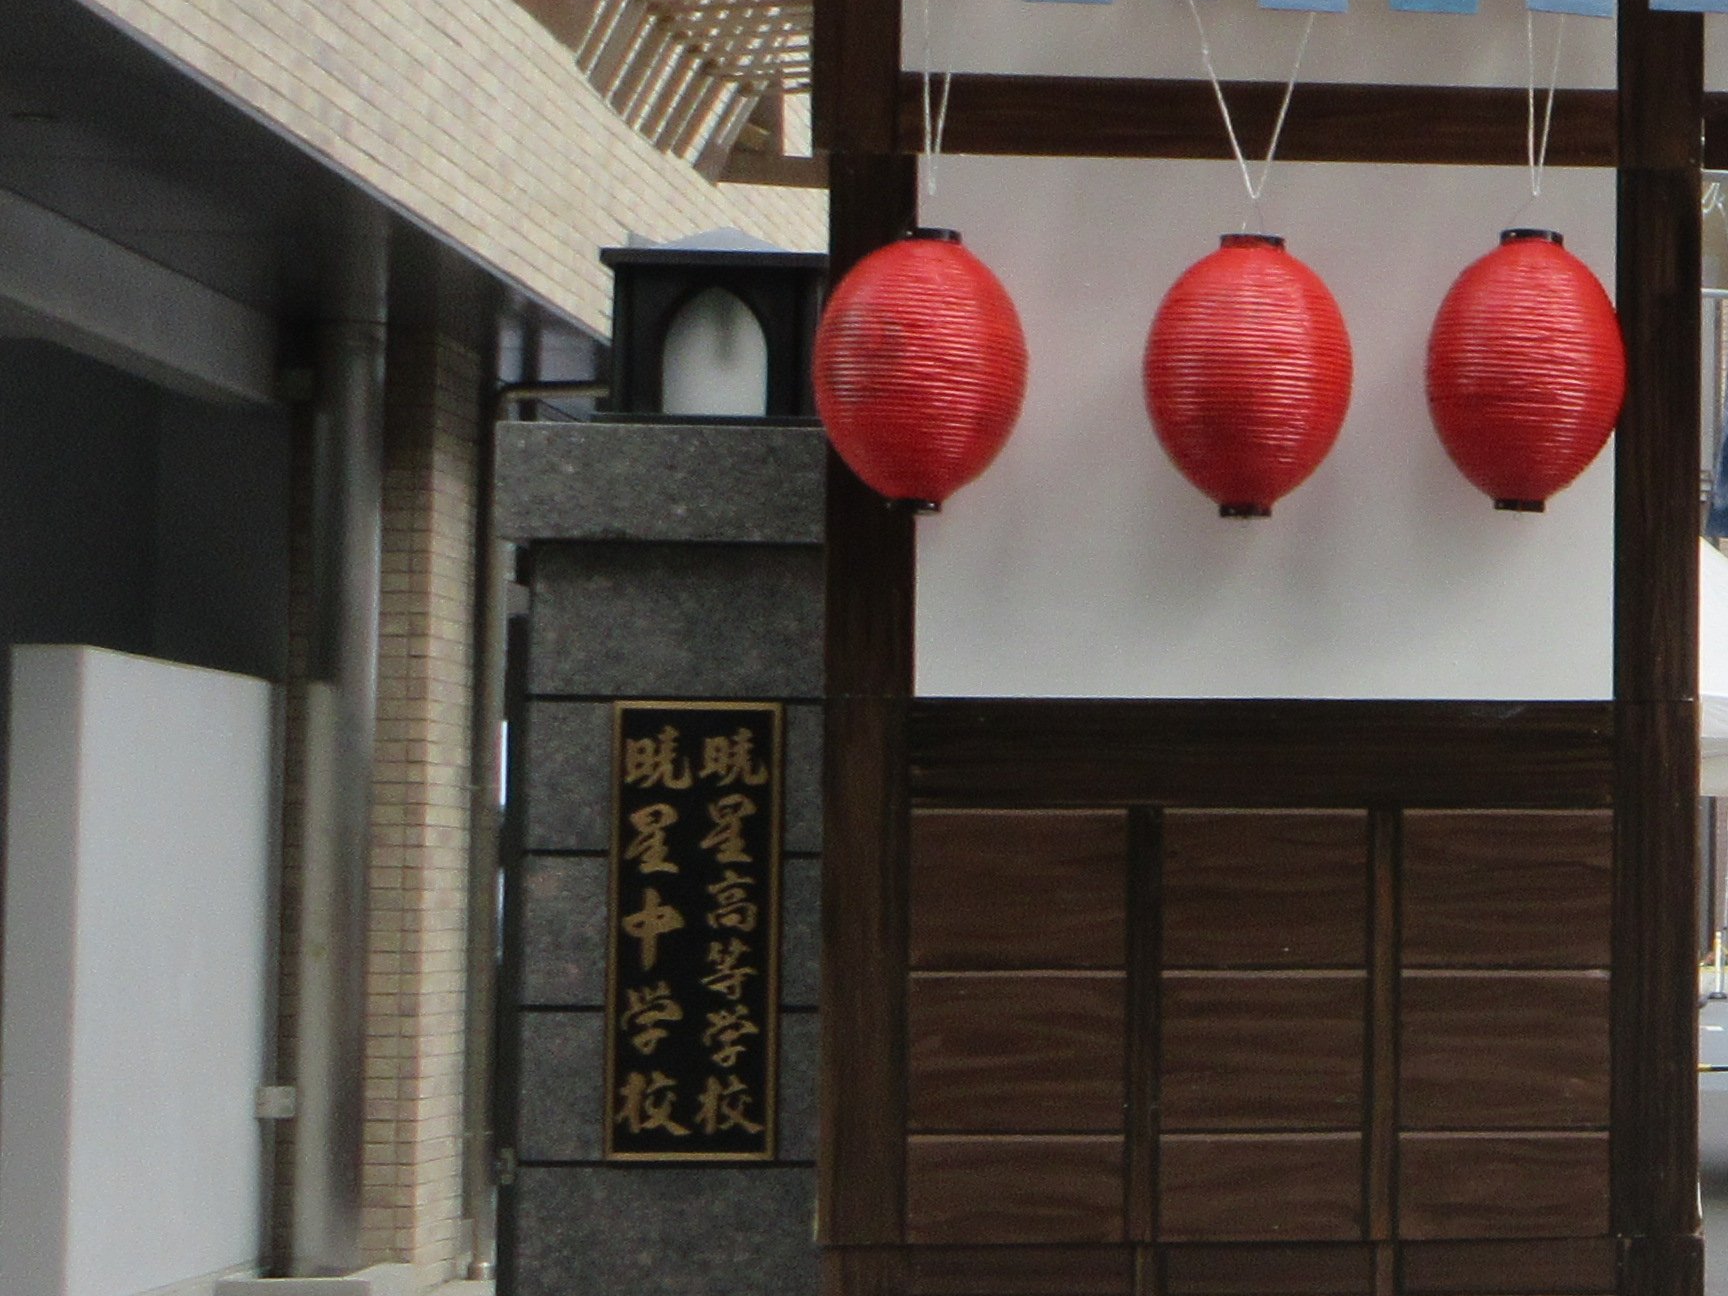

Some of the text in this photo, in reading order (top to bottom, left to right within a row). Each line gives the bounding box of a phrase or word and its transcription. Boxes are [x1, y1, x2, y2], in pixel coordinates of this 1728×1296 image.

[616, 726, 694, 1137] 暁星中学校
[697, 728, 769, 1137] 暁星高等学校
